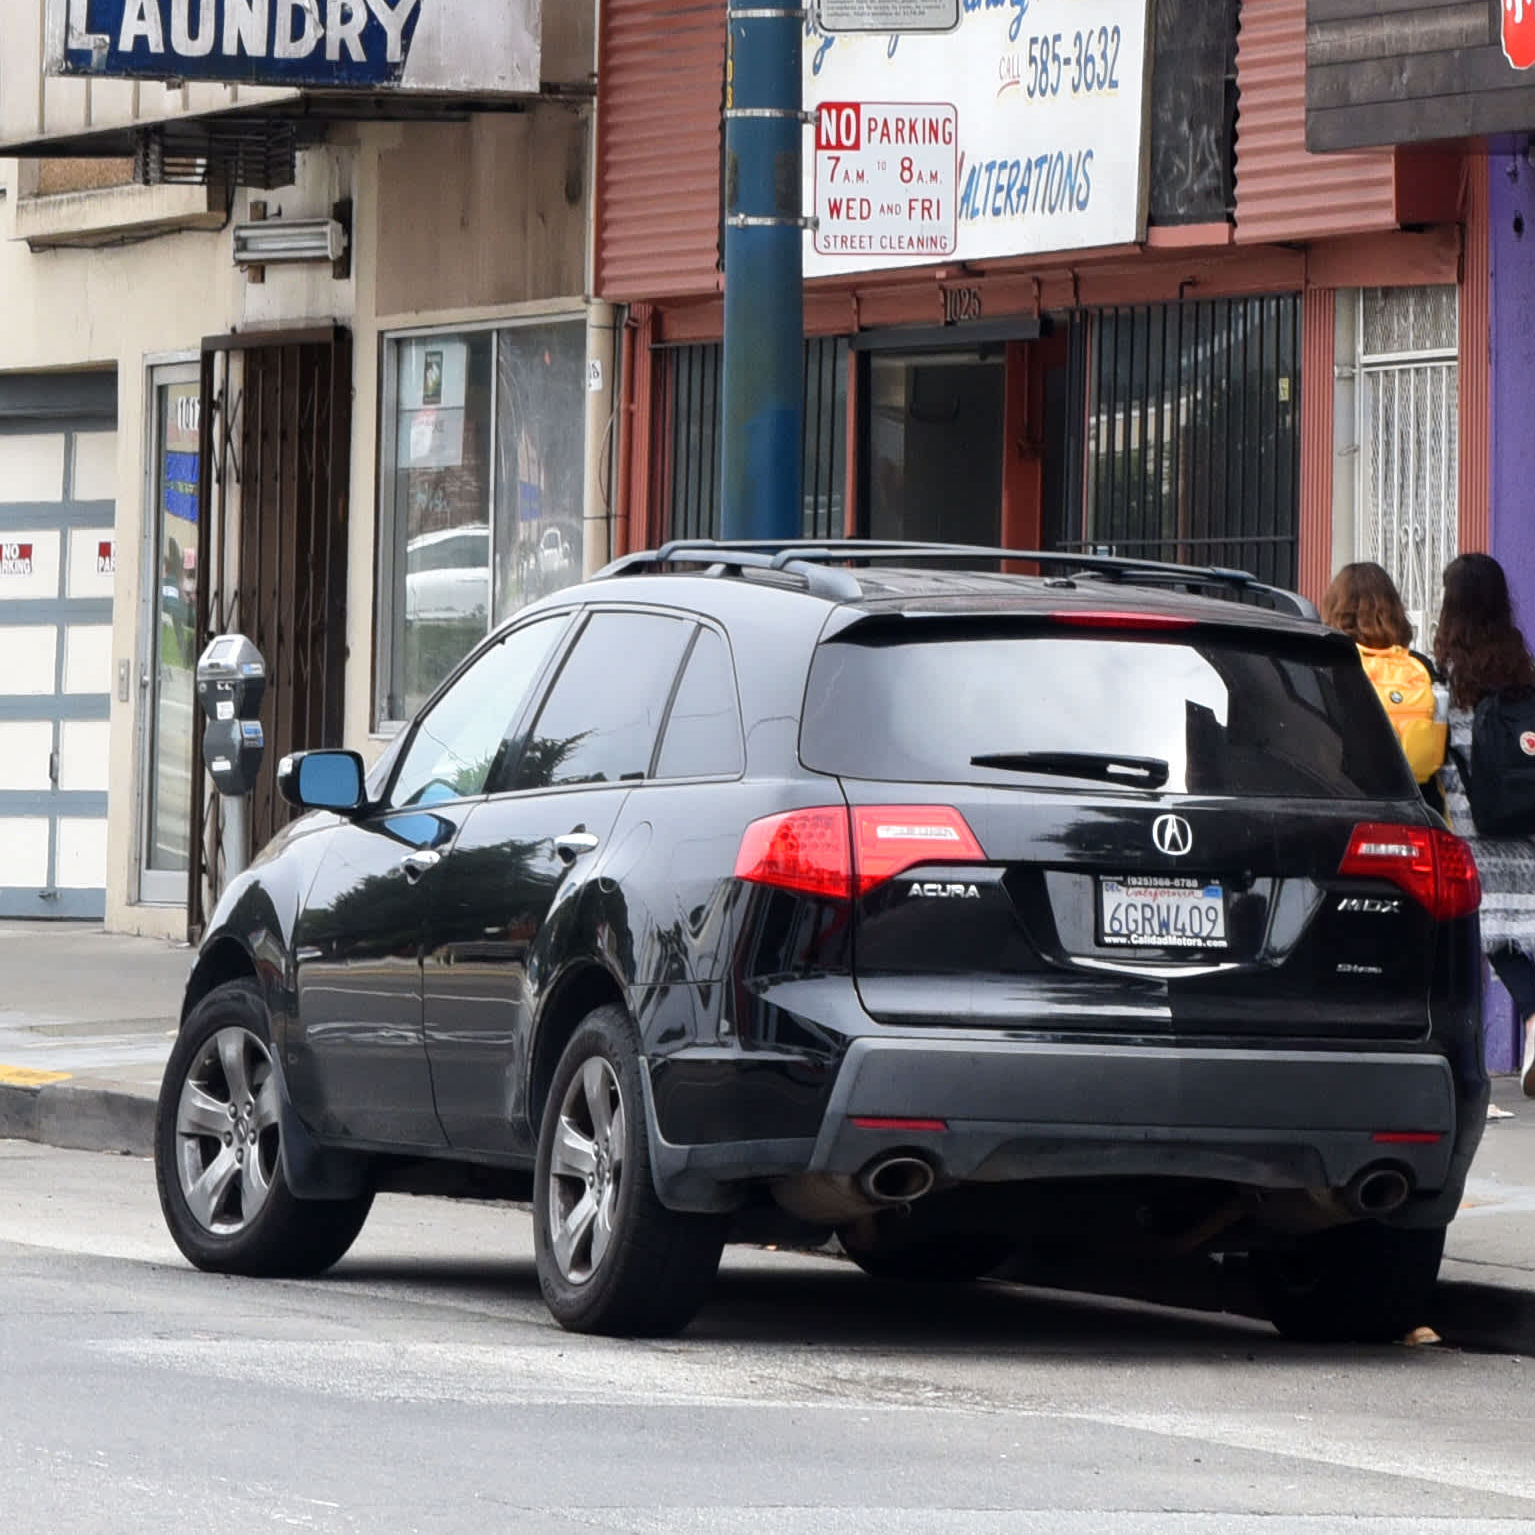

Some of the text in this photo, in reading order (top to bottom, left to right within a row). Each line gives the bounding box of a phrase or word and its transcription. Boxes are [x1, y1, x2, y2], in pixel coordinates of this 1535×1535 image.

[999, 24, 1122, 99] CALL 585-3632
[820, 107, 953, 147] NO PARKING
[827, 155, 841, 184] 7
[877, 159, 887, 171] TO
[899, 156, 914, 184] 8
[959, 148, 1095, 221] ALTERATIONS
[828, 197, 941, 221] WED AND FRI
[823, 234, 948, 251] STREET CLEANING
[943, 286, 982, 323] 1025
[907, 882, 981, 899] ACURA
[1126, 887, 1196, 902] California
[1337, 897, 1402, 913] MDX
[1109, 902, 1219, 937] 6GRW409
[1103, 934, 1228, 948] www.CalidadMotors.com
